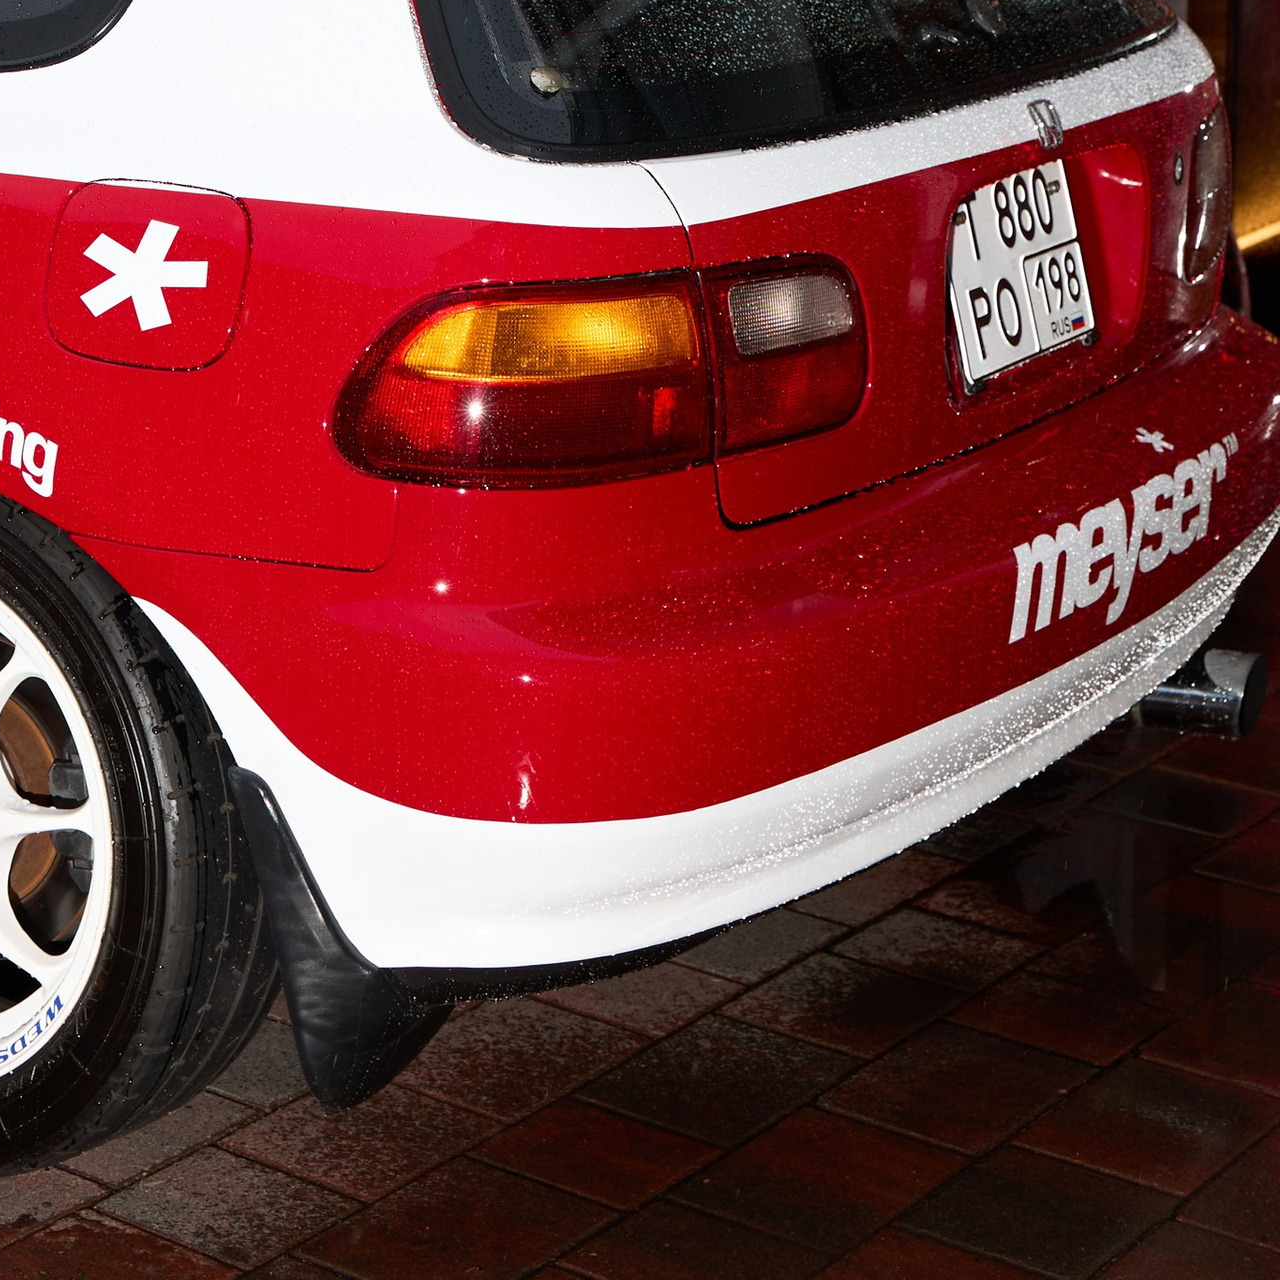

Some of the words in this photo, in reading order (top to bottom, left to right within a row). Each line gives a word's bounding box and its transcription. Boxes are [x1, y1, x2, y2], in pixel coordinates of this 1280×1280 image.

[992, 168, 1055, 249] 880
[1034, 251, 1082, 315] 198
[1051, 316, 1071, 340] RUS
[1008, 442, 1228, 645] meyser
